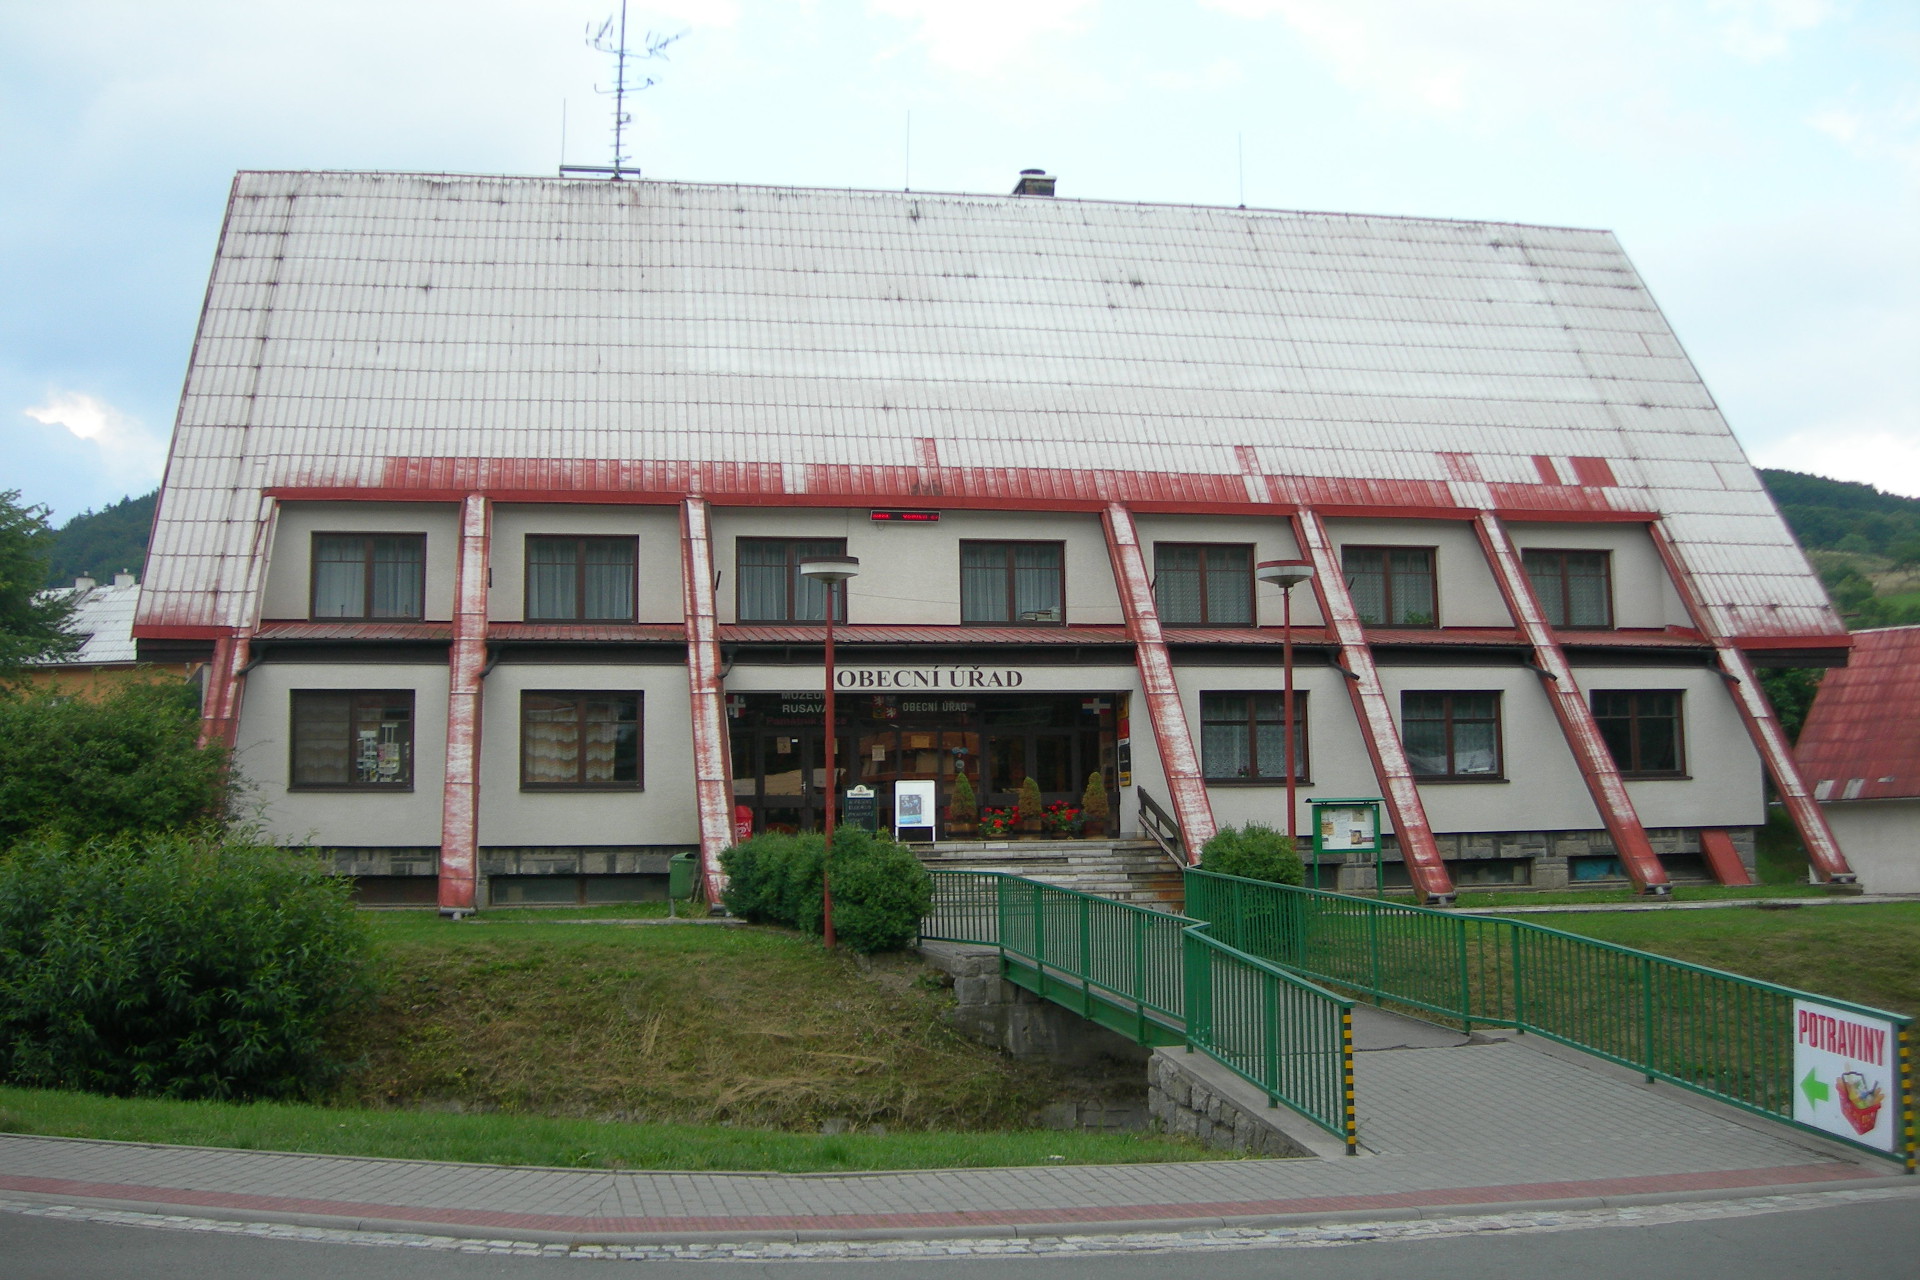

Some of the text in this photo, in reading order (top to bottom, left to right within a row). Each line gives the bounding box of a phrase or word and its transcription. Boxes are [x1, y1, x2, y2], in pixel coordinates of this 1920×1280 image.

[836, 665, 1023, 687] OBECNÍ ÚŘAD
[781, 692, 827, 700] MUZEU
[902, 700, 938, 712] OBECNÍ
[1798, 1009, 1885, 1066] POTRAVINY
